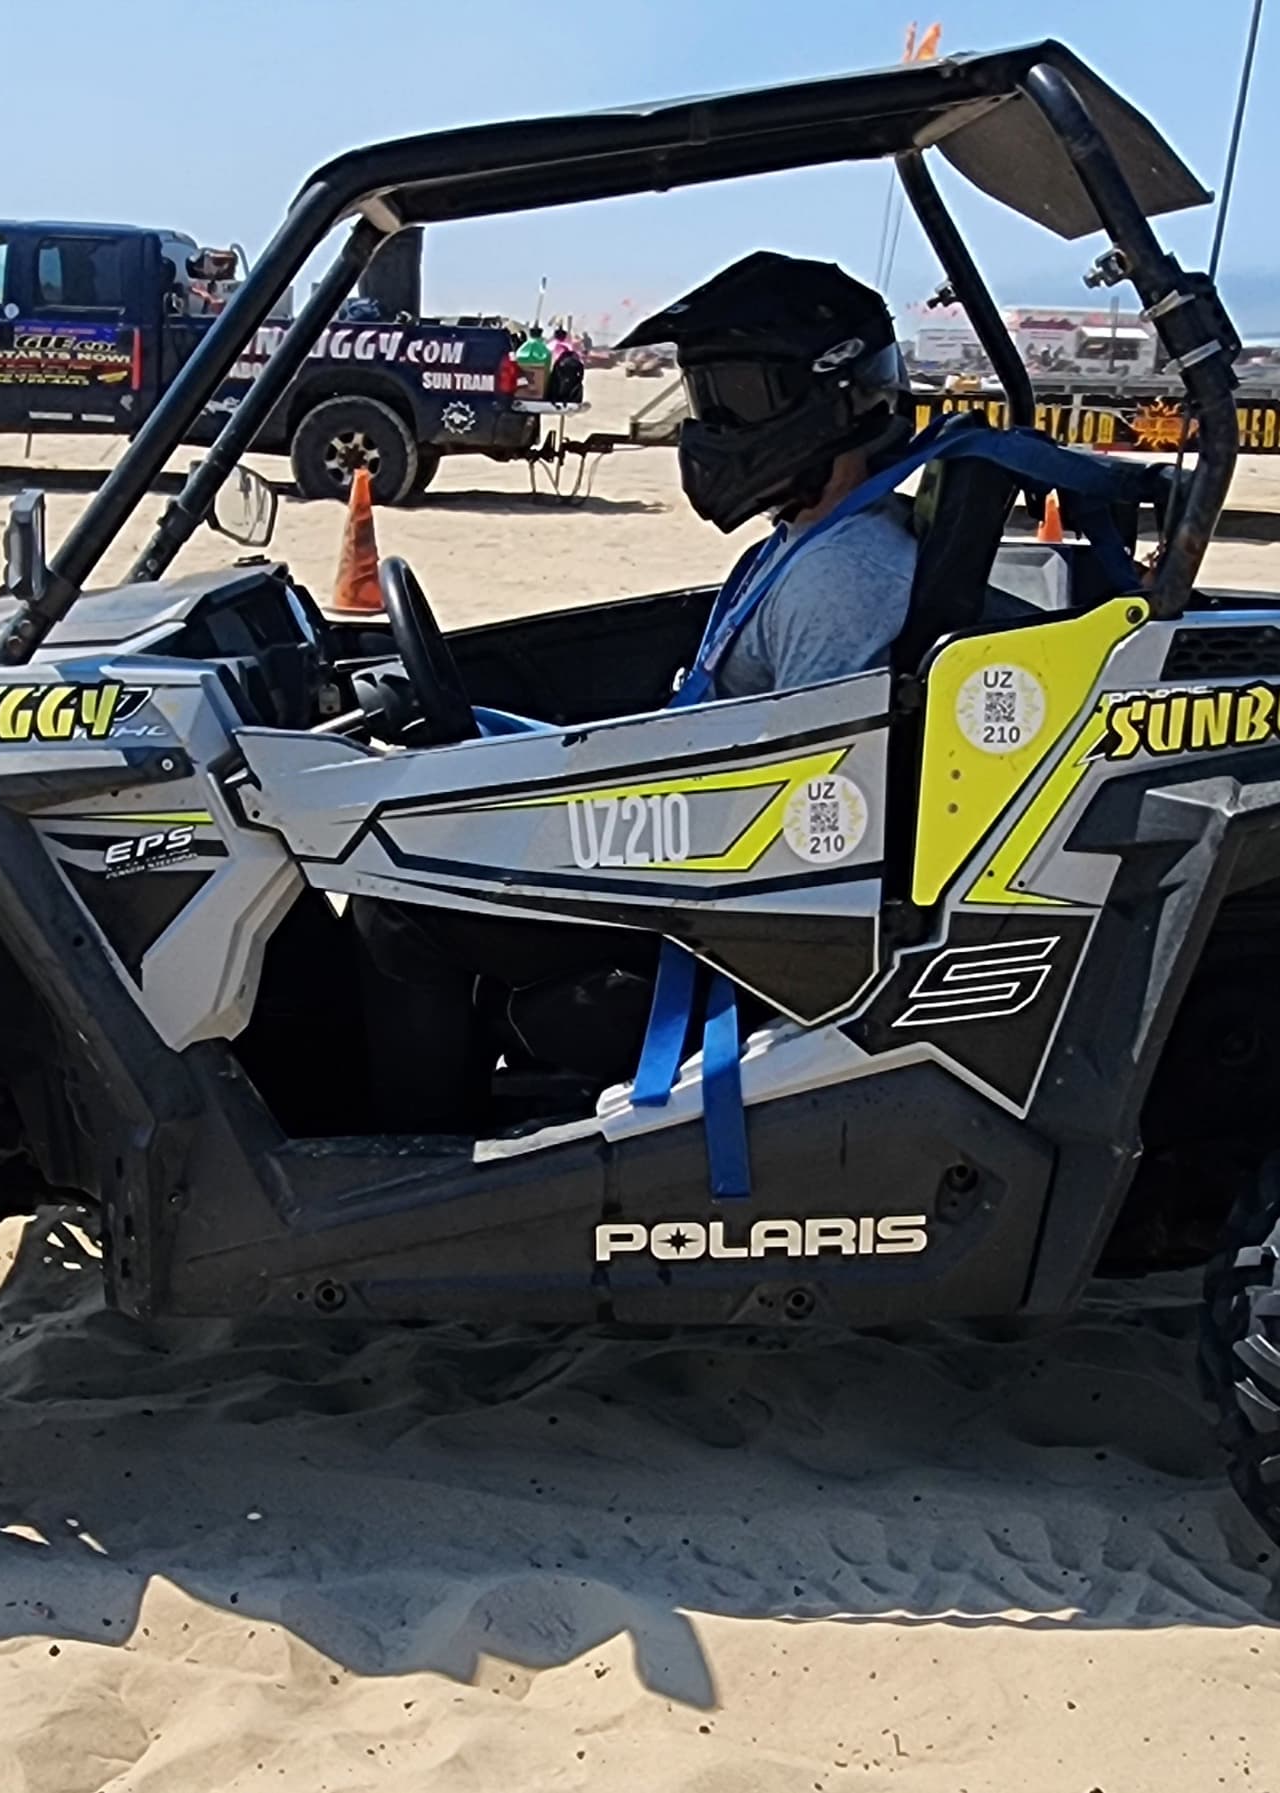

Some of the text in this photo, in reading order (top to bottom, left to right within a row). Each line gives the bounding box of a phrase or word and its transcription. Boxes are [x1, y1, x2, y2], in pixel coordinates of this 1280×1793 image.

[76, 351, 132, 364] NOW!
[422, 370, 495, 392] SUN TRAM
[982, 670, 1014, 689] UZ
[983, 726, 1021, 744] 210
[807, 782, 836, 800] UZ
[567, 792, 690, 869] UZ210
[105, 825, 195, 863] EPS
[809, 835, 846, 854] 210
[595, 1215, 927, 1262] POLARIS
